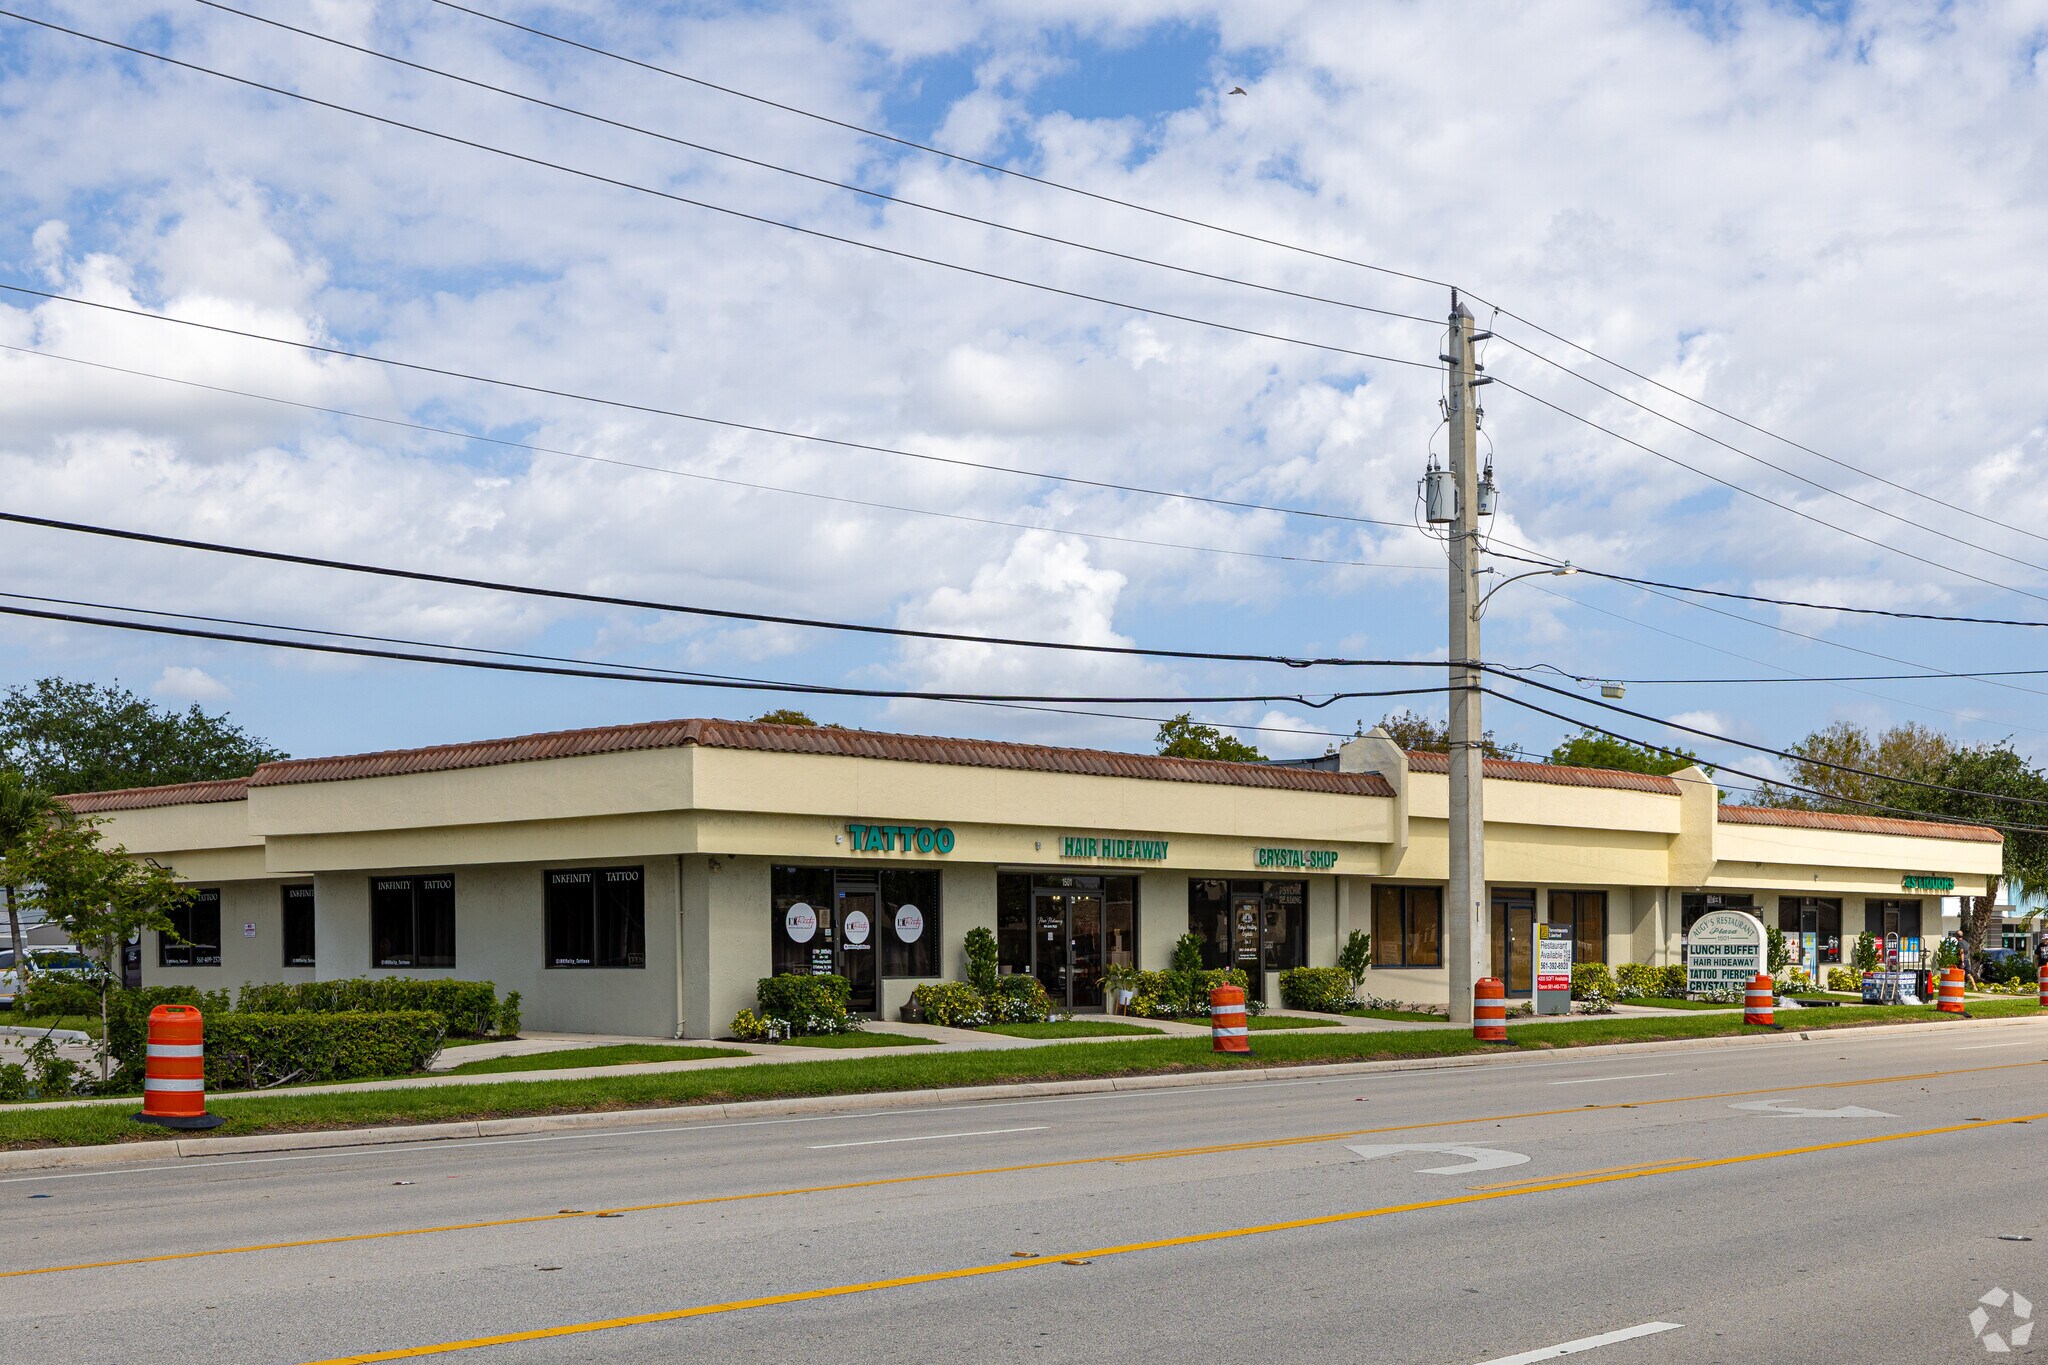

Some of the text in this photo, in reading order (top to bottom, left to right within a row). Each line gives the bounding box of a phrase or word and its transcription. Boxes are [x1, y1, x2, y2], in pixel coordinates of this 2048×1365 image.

[848, 824, 955, 853] TATTOO
[1064, 836, 1169, 860] HAIR HIDEAWAY
[1258, 847, 1339, 868] CRYSTAL SHOP
[552, 871, 639, 884] INKFINITY TATTOO
[1917, 876, 1955, 890] LIQUORS
[378, 879, 452, 891] INKFINITY TATTOO
[1692, 916, 1756, 938] AUGY'S RESTAURANT
[1708, 926, 1738, 935] Plaza
[1540, 940, 1568, 949] Restaurant
[1690, 945, 1760, 955] LUNCH BUFFET
[1540, 951, 1563, 959] Available
[1693, 958, 1755, 967] HAIR HIDEAWAY
[1689, 969, 1718, 979] TATTOO
[1689, 981, 1728, 991] CRYSTAL
